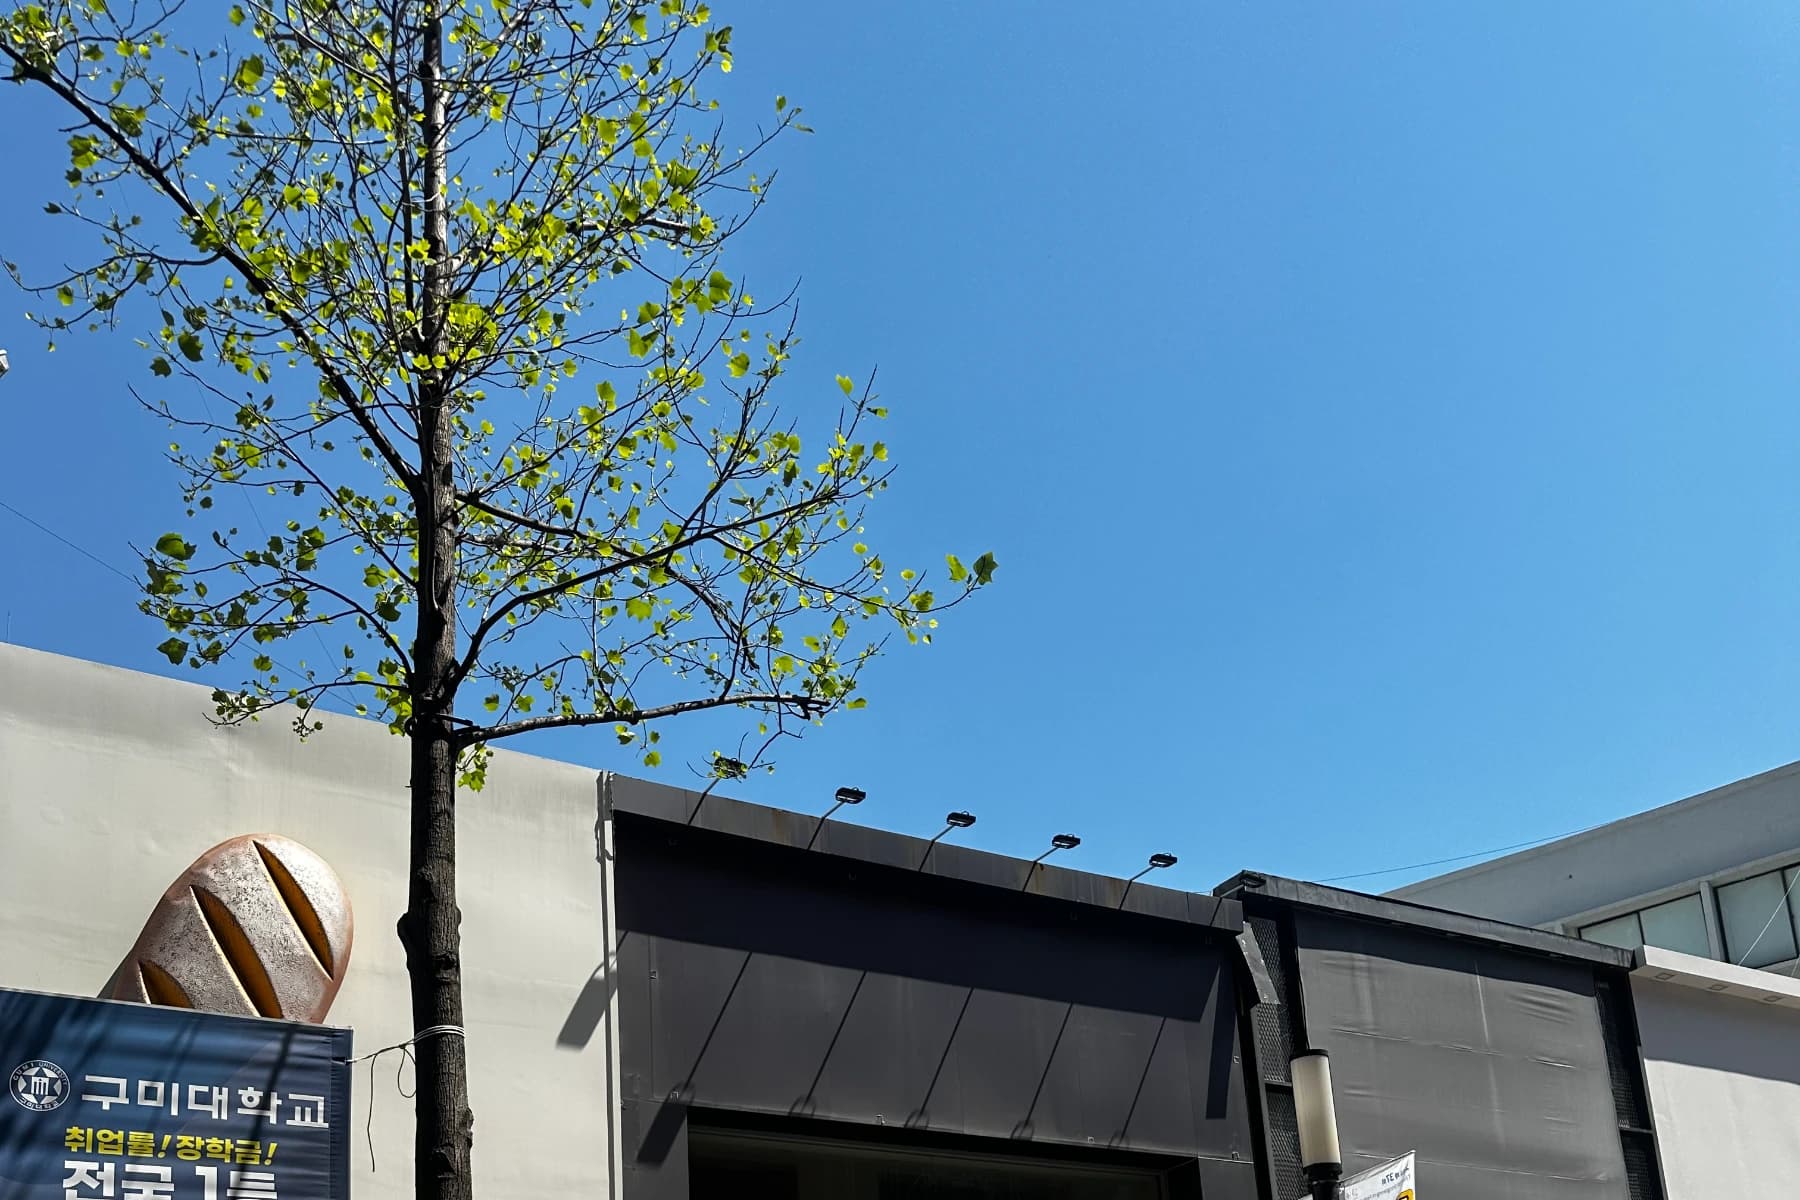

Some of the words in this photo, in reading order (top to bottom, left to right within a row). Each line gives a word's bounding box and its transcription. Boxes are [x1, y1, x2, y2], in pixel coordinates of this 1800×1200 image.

[82, 1075, 329, 1128] 구미대학교
[64, 1126, 172, 1158] 취업률!
[176, 1135, 278, 1166] 장학금!
